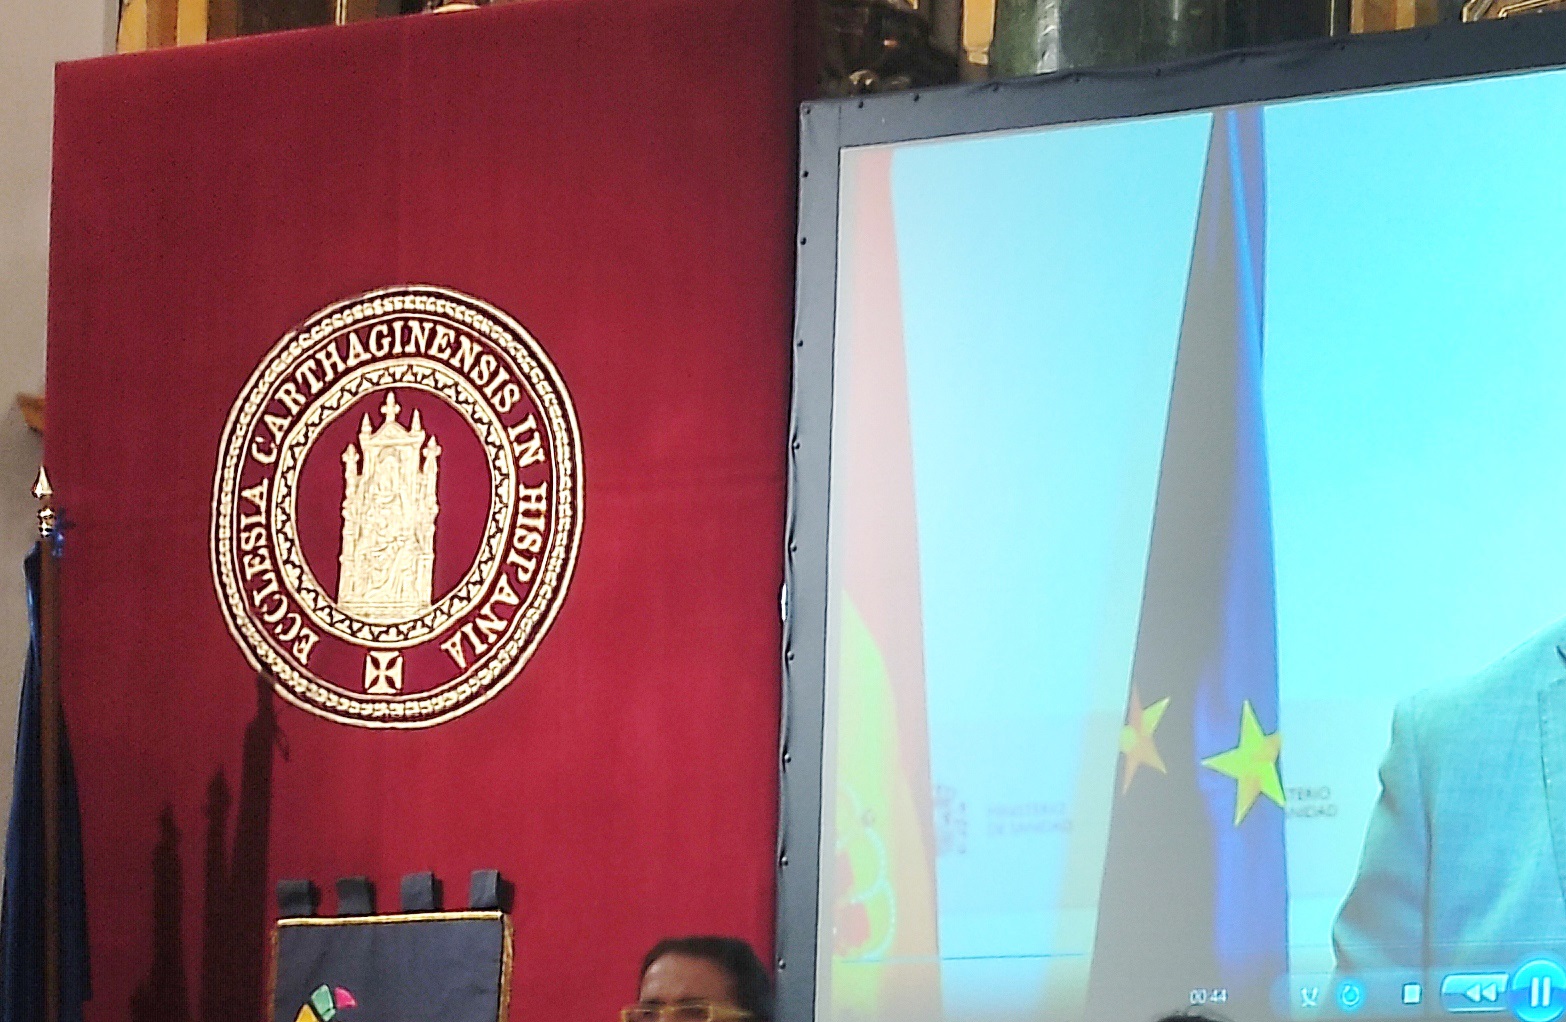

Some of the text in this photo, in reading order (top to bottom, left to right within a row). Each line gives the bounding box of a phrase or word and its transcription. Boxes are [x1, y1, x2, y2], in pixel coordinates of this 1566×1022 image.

[240, 319, 548, 670] ECCLESIA CARTHAGINENSIS IN HISPANIA
